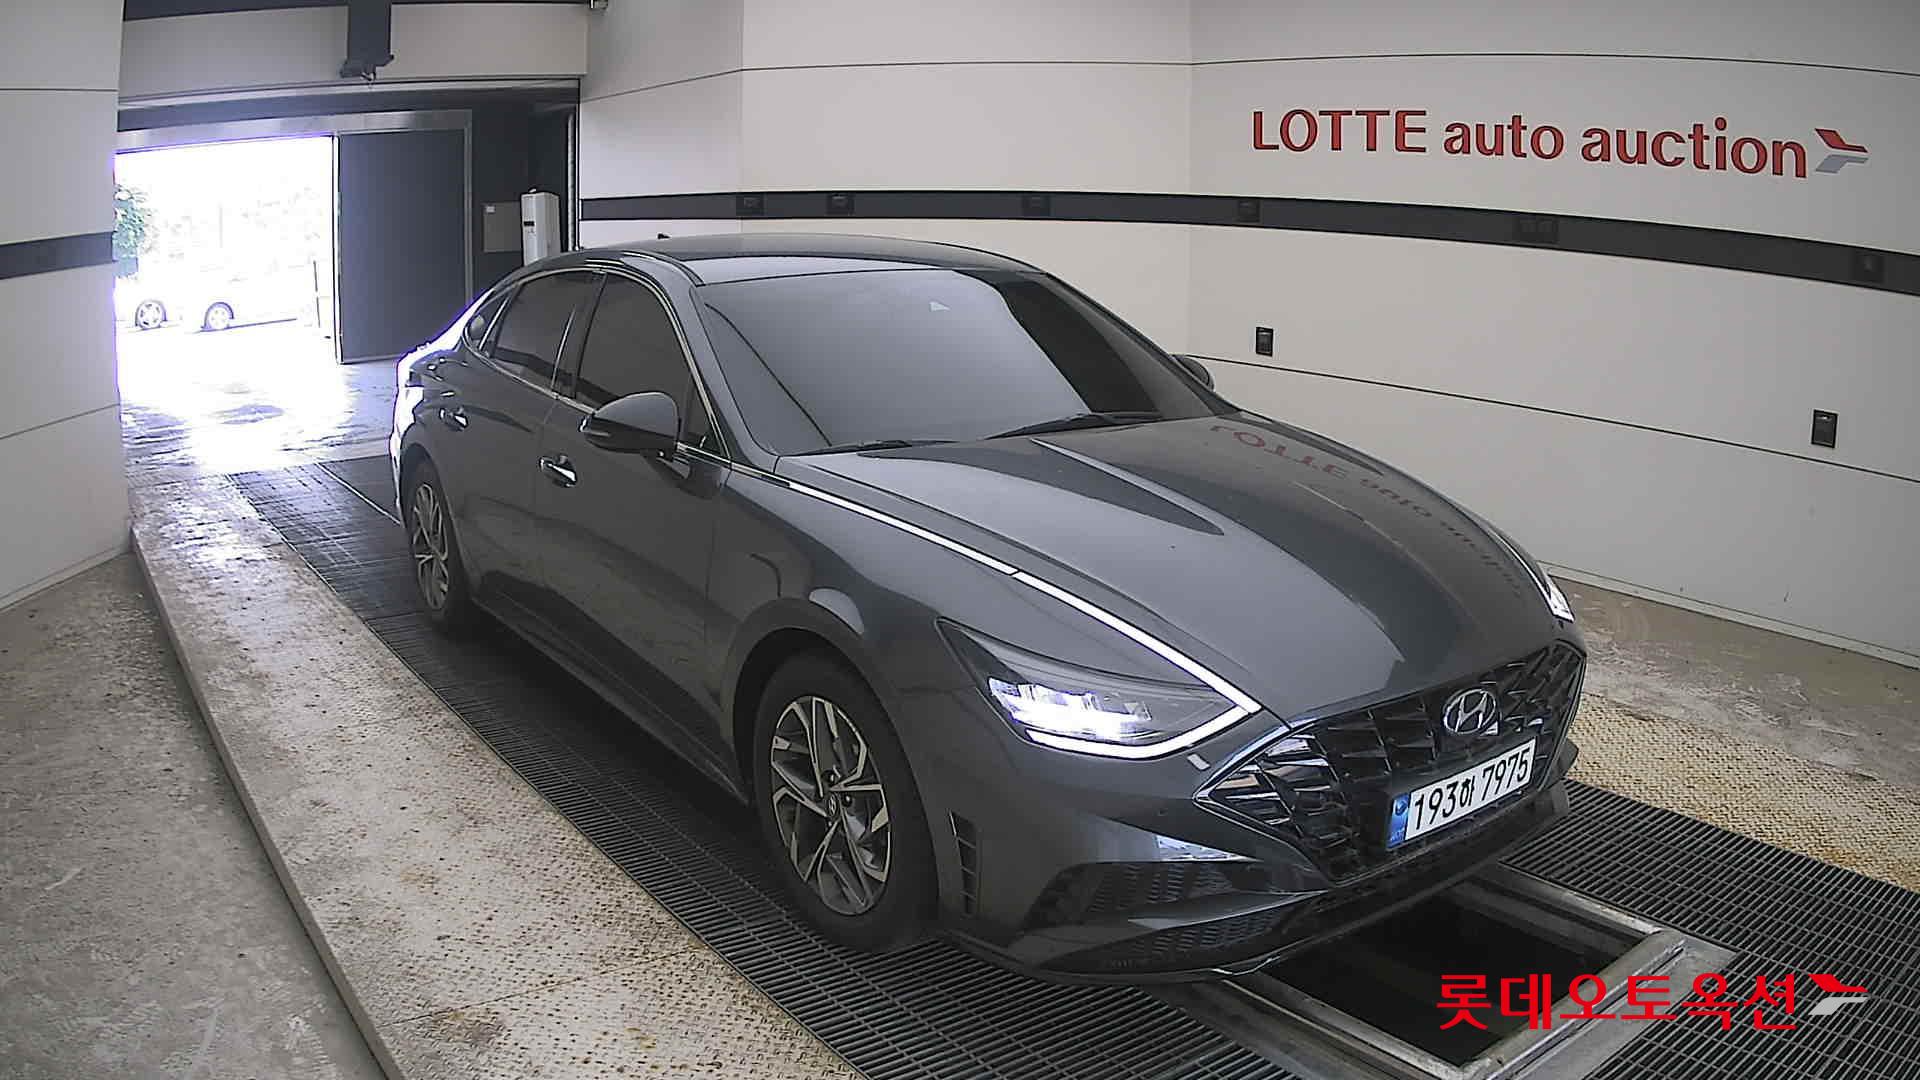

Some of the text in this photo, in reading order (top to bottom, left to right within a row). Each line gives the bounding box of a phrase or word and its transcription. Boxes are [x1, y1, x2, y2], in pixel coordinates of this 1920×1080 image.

[1252, 109, 1808, 179] LOTTE auto auction
[1414, 748, 1531, 830] 193하 7975
